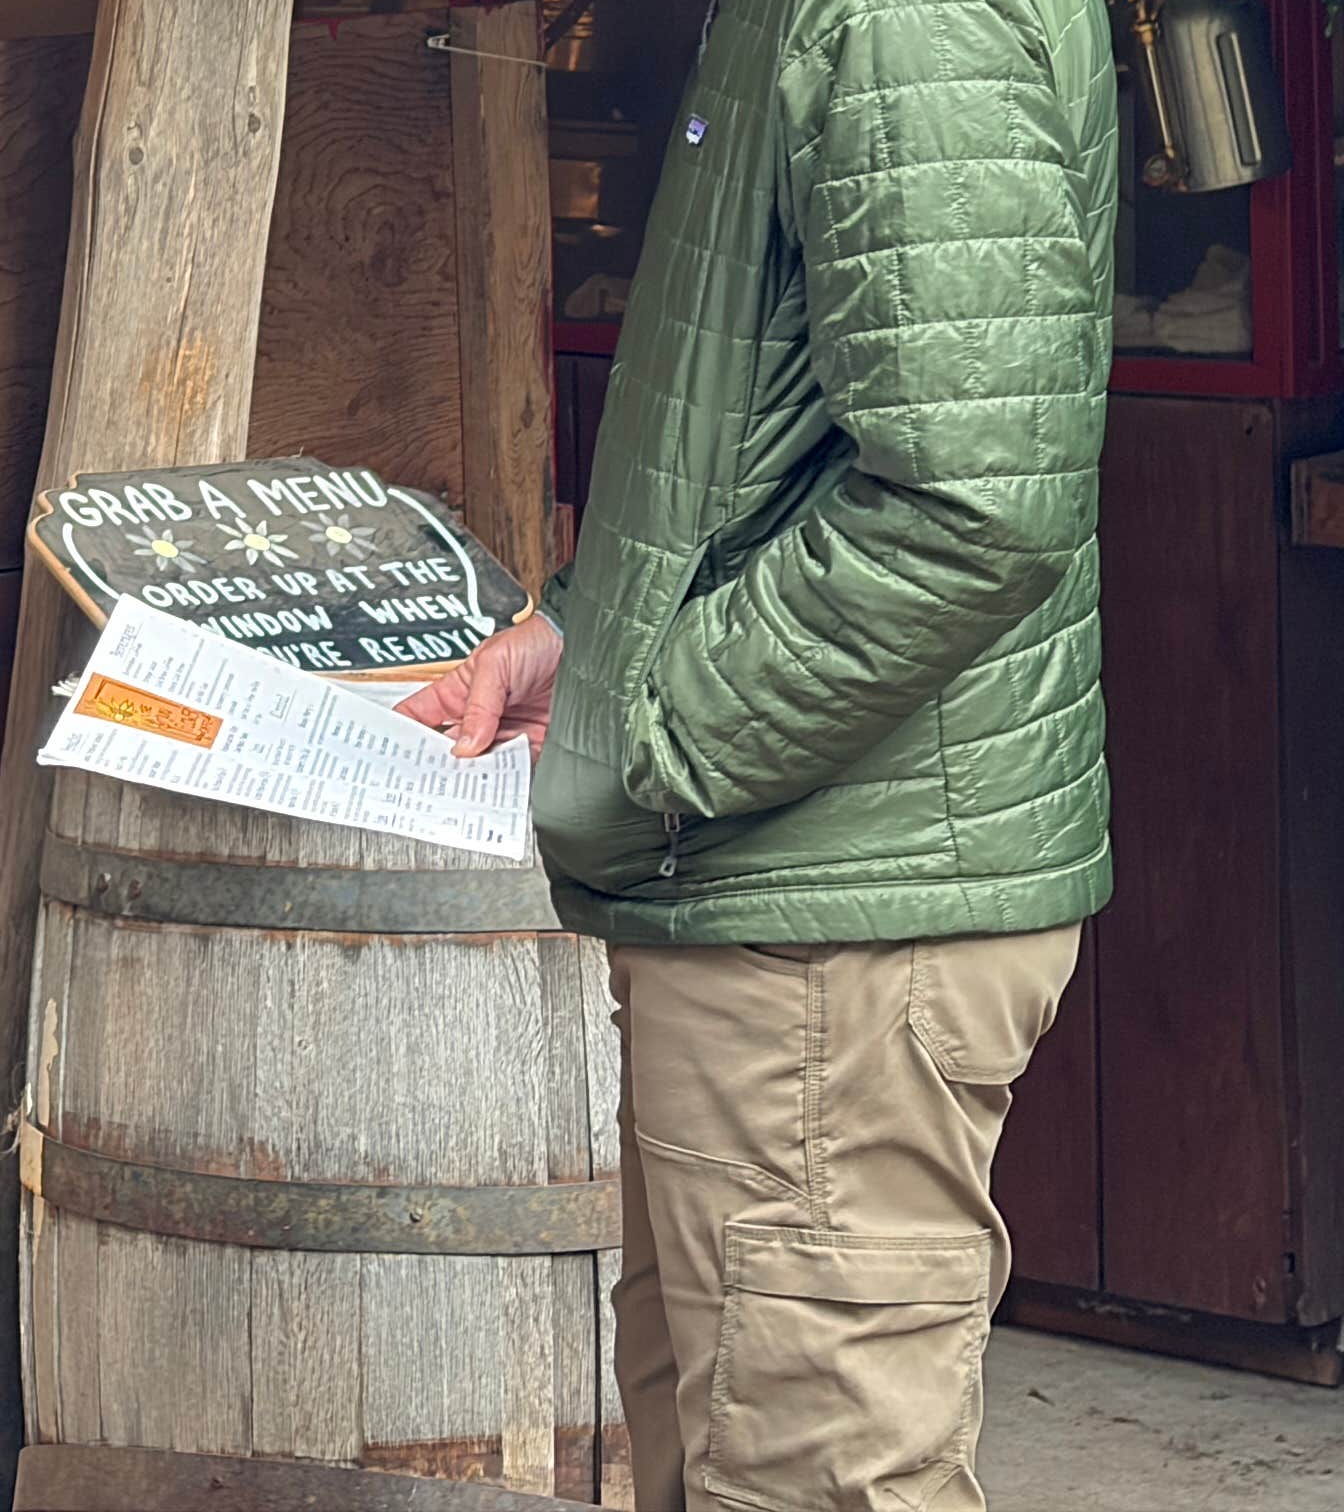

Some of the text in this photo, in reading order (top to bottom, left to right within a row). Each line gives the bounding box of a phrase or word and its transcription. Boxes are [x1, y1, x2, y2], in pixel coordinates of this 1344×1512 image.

[58, 469, 389, 528] GRAB A MENU
[141, 555, 463, 609] ORDER UP AT THE
[360, 591, 471, 626] WHEN
